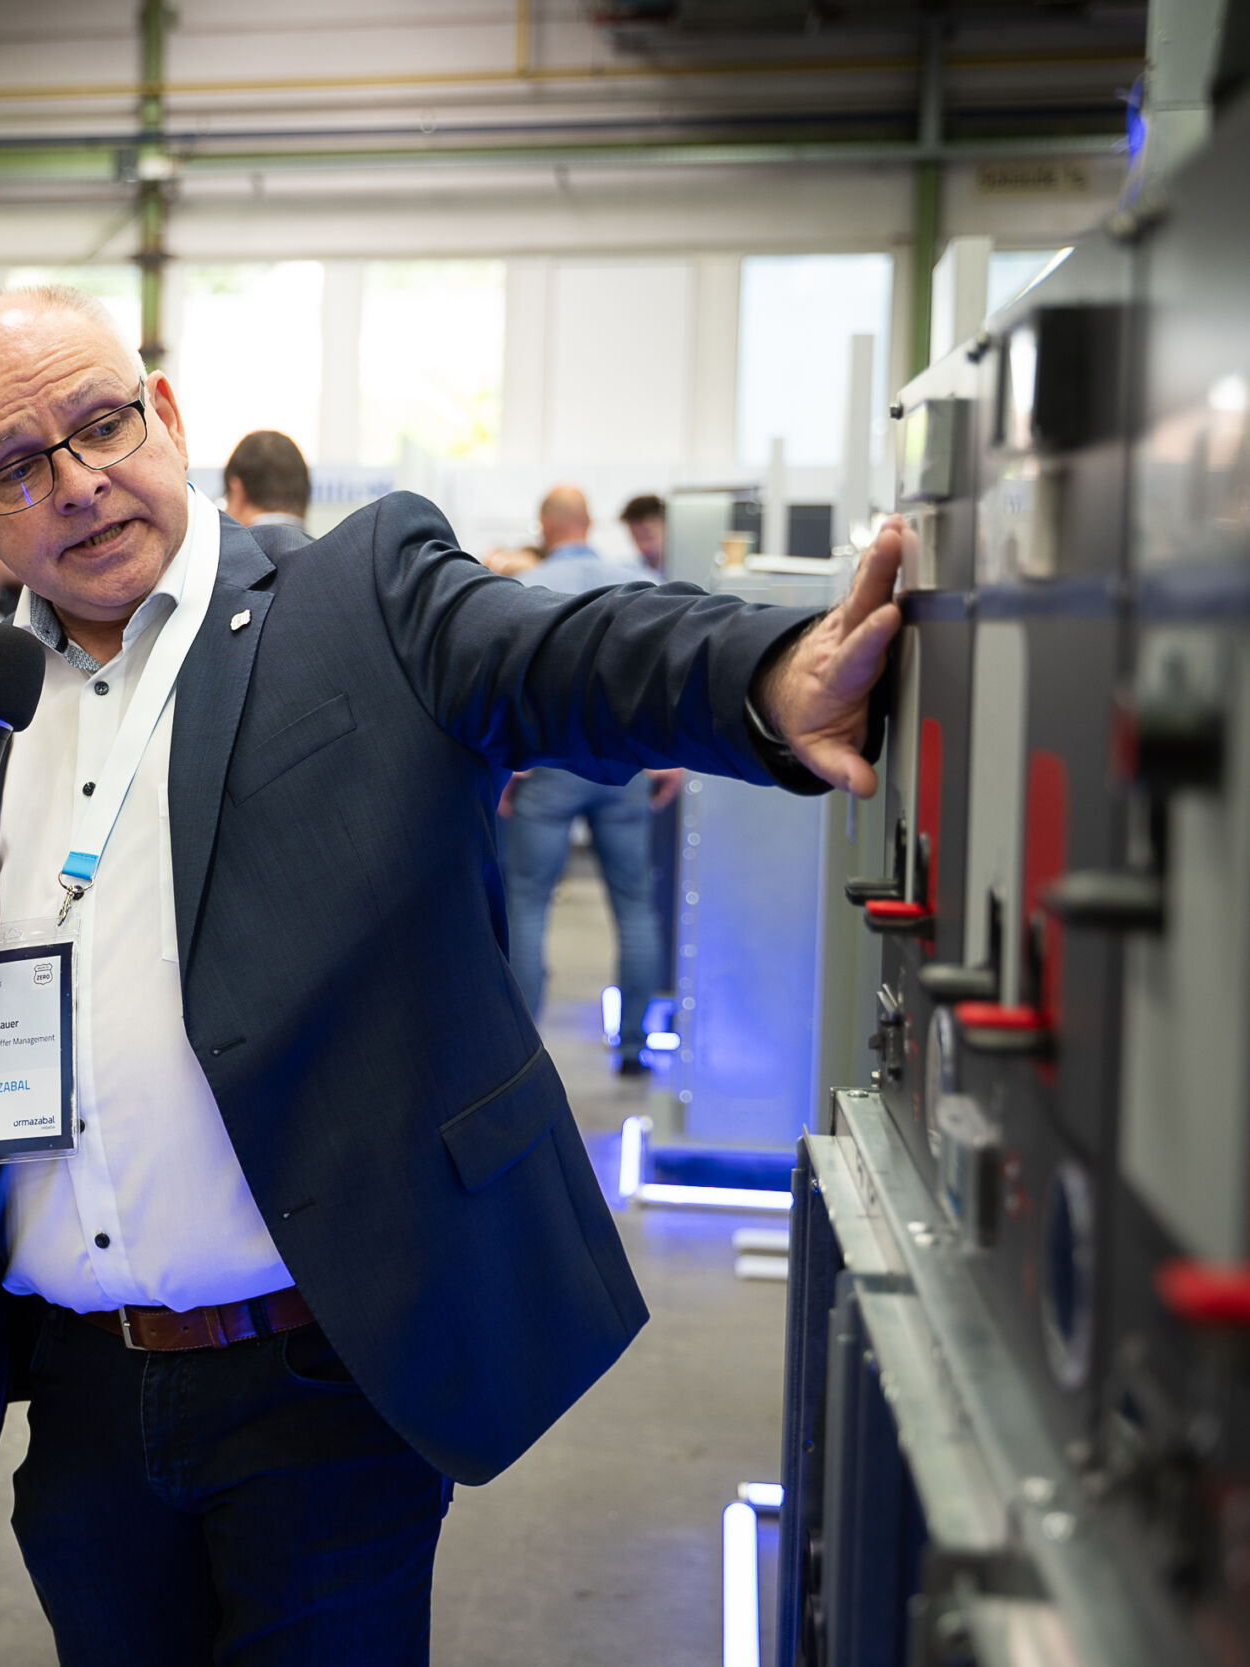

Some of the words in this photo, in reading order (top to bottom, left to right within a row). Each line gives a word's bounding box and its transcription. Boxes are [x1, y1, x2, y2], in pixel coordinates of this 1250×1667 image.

[36, 973, 51, 981] ZERO
[12, 1034, 55, 1046] Management
[13, 1115, 56, 1128] ormazabal
